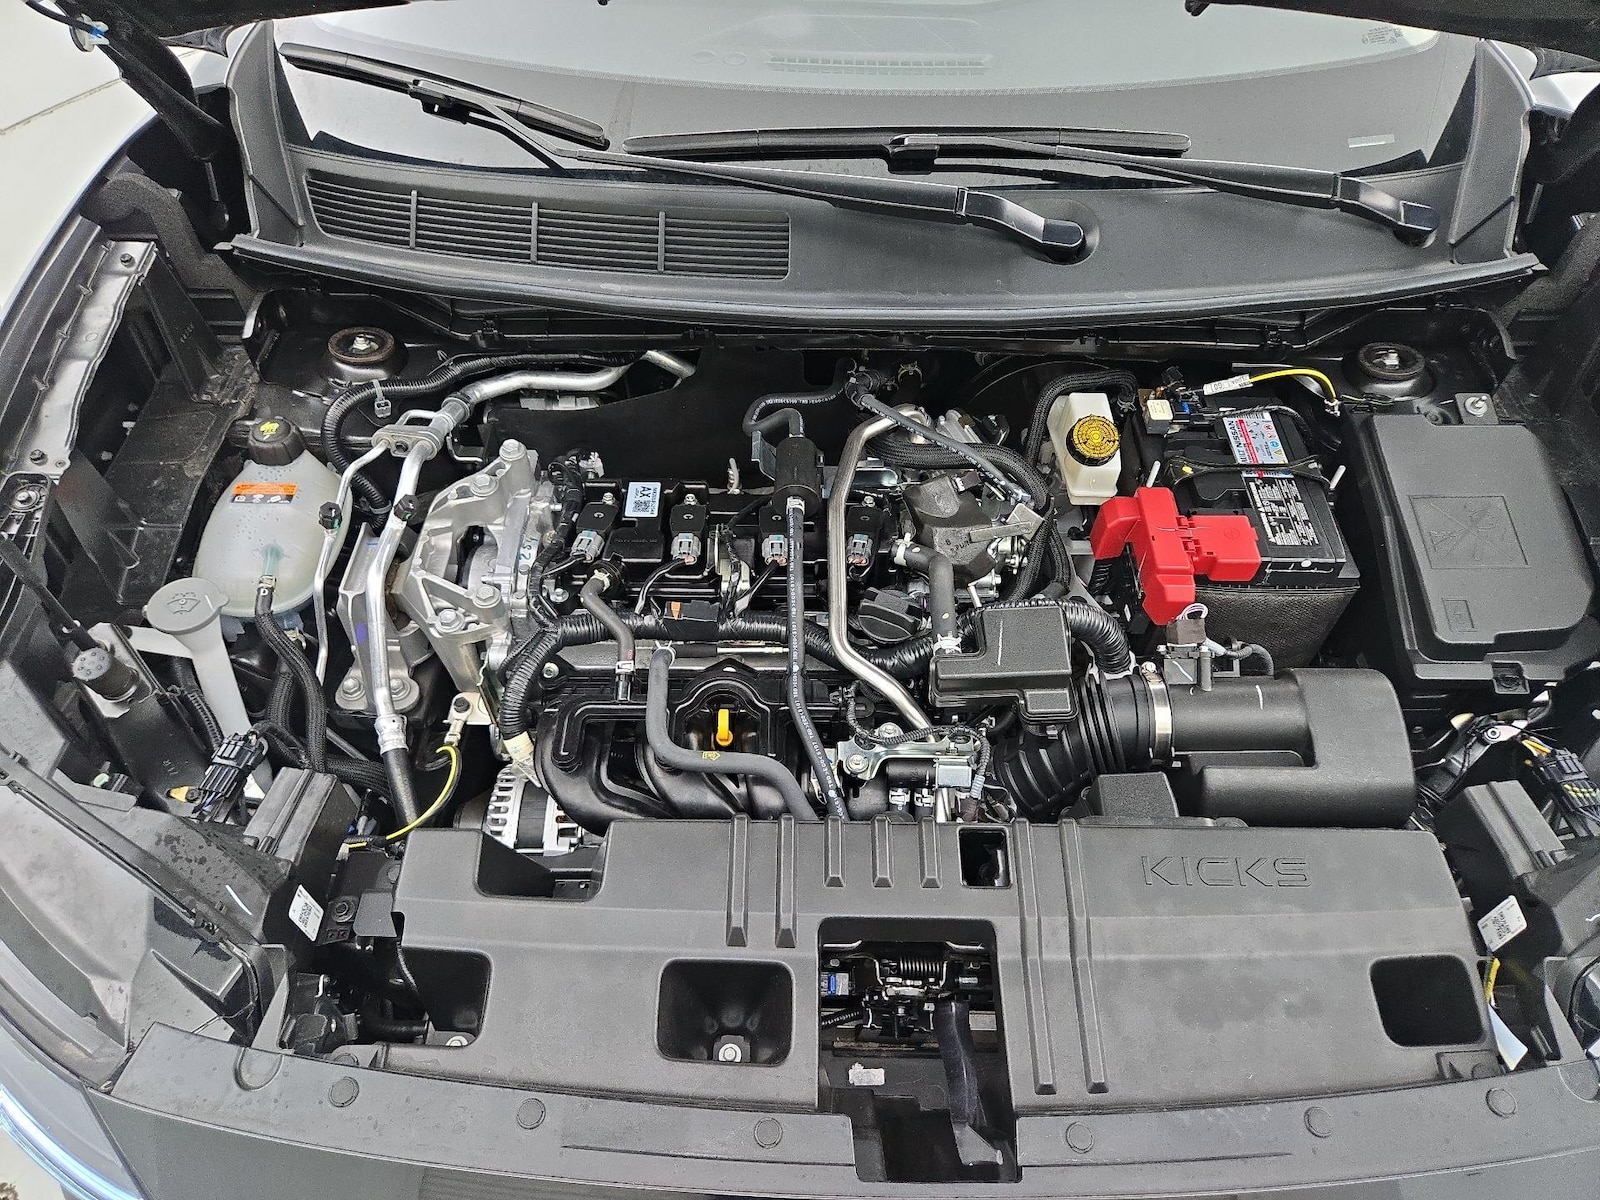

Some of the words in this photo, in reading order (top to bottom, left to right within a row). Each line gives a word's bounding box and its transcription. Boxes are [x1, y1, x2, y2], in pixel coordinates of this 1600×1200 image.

[1227, 420, 1243, 448] NISSAN
[639, 486, 652, 499] AX
[1141, 856, 1312, 888] KICKS
